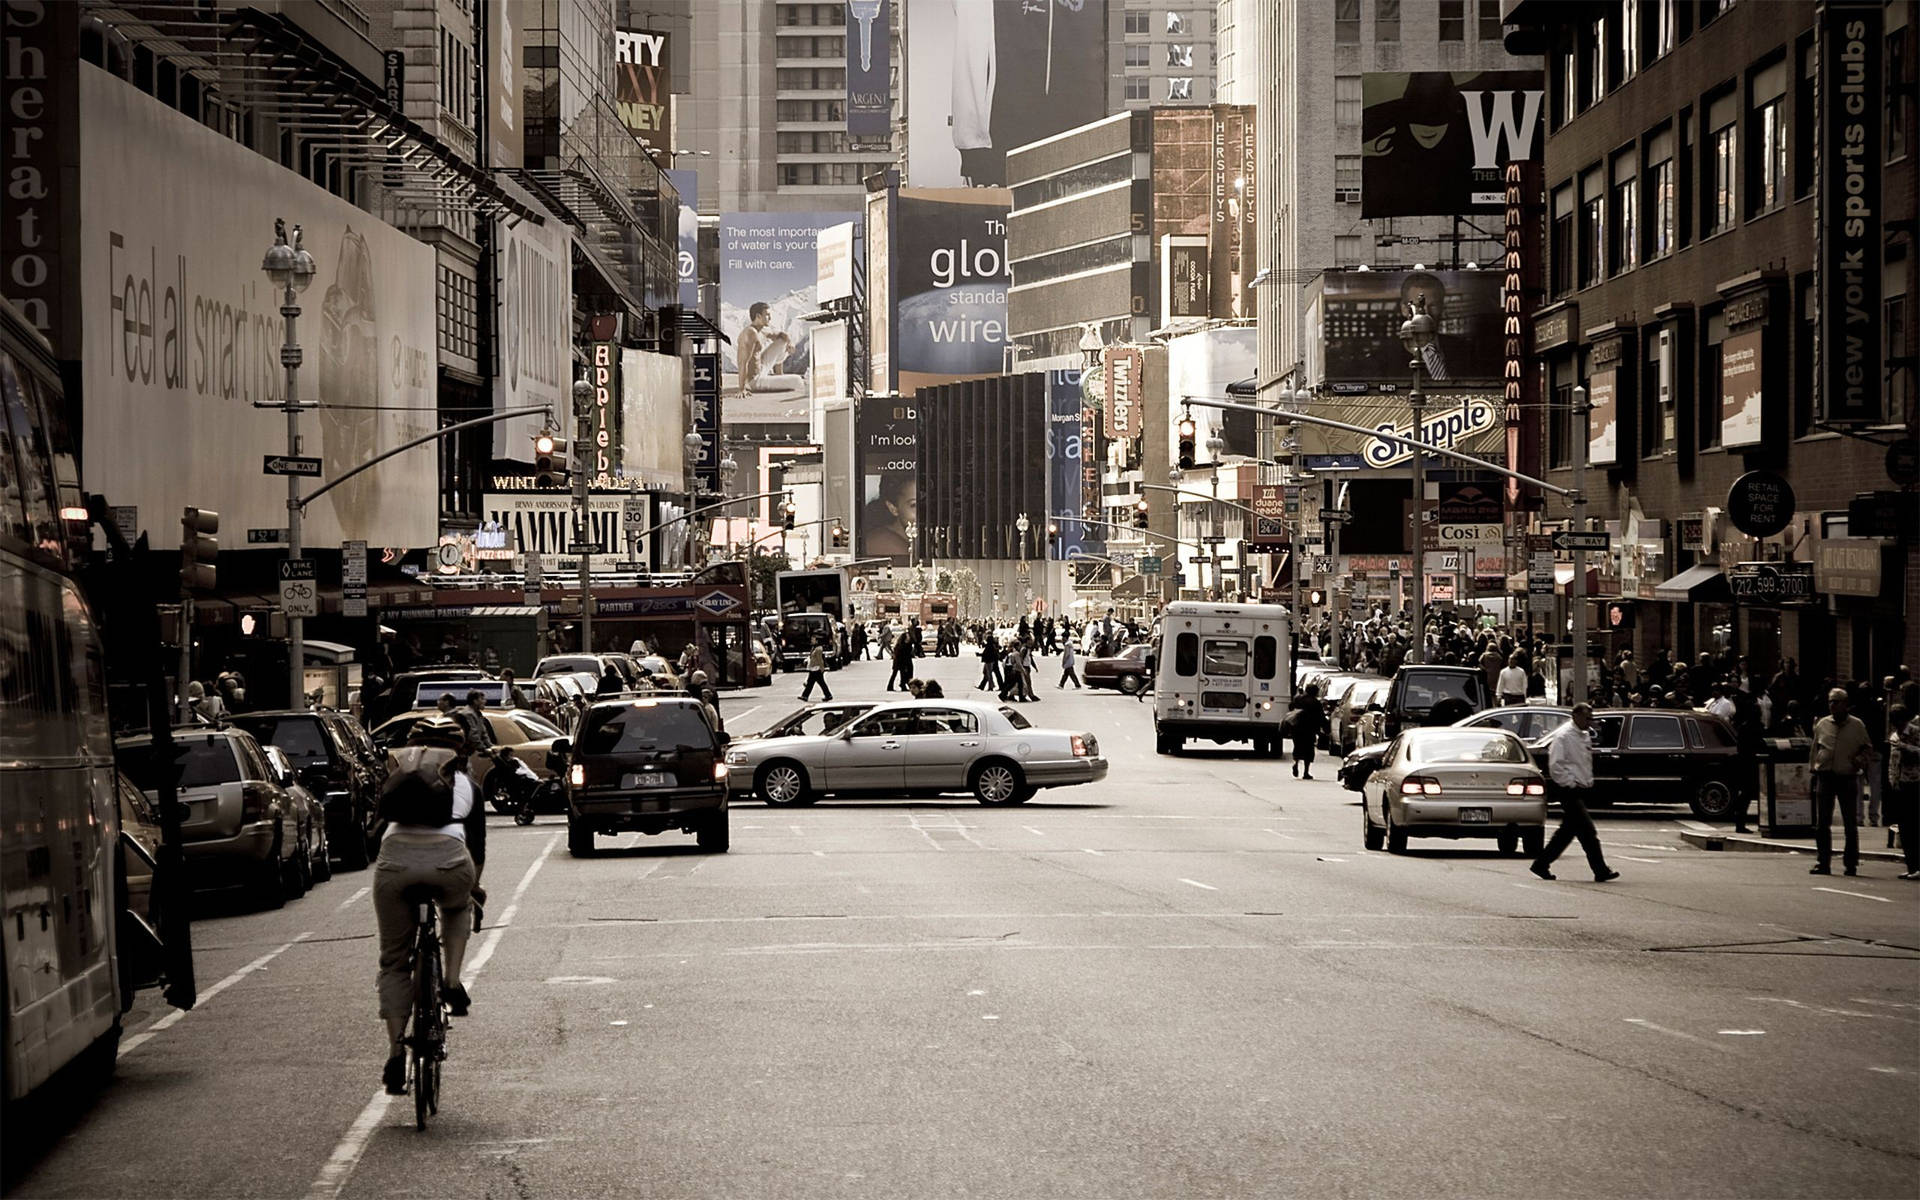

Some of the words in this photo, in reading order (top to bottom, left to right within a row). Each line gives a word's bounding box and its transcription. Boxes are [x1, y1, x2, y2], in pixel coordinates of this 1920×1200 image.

[1841, 18, 1866, 114] clubs
[616, 101, 664, 131] NEY
[5, 0, 50, 331] Sheraton
[1842, 122, 1870, 239] sports
[727, 227, 746, 237] The
[750, 227, 775, 237] most
[778, 227, 827, 240] importa
[985, 220, 1008, 235] Th
[728, 241, 738, 250] of
[741, 241, 769, 250] water
[773, 240, 782, 250] is
[785, 241, 808, 252] your
[728, 259, 742, 270] Fill
[745, 259, 767, 270] with
[770, 260, 795, 270] care.
[1841, 248, 1870, 325] york
[949, 289, 1007, 305] standa
[109, 230, 156, 385] Feel
[164, 254, 188, 389] all
[194, 282, 248, 401] smart
[1844, 335, 1866, 408] new
[1114, 355, 1134, 431] Twizzlers
[1051, 413, 1075, 424] Morgan
[1372, 399, 1486, 462] Snapple
[870, 434, 890, 446] I'm
[272, 461, 288, 470] ONE
[297, 463, 314, 471] WAY
[569, 476, 645, 490] ARDEN
[1748, 482, 1781, 492] RETAIL
[1255, 498, 1284, 507] duane
[1748, 493, 1779, 502] SPACE
[1753, 503, 1774, 512] FOR
[625, 512, 642, 522] 30
[1750, 513, 1776, 523] RENT
[1441, 525, 1480, 540] Così
[1560, 537, 1577, 545] ONE
[1585, 537, 1604, 545] WAY
[288, 604, 309, 613] ONLY
[600, 602, 634, 612] PARTNER
